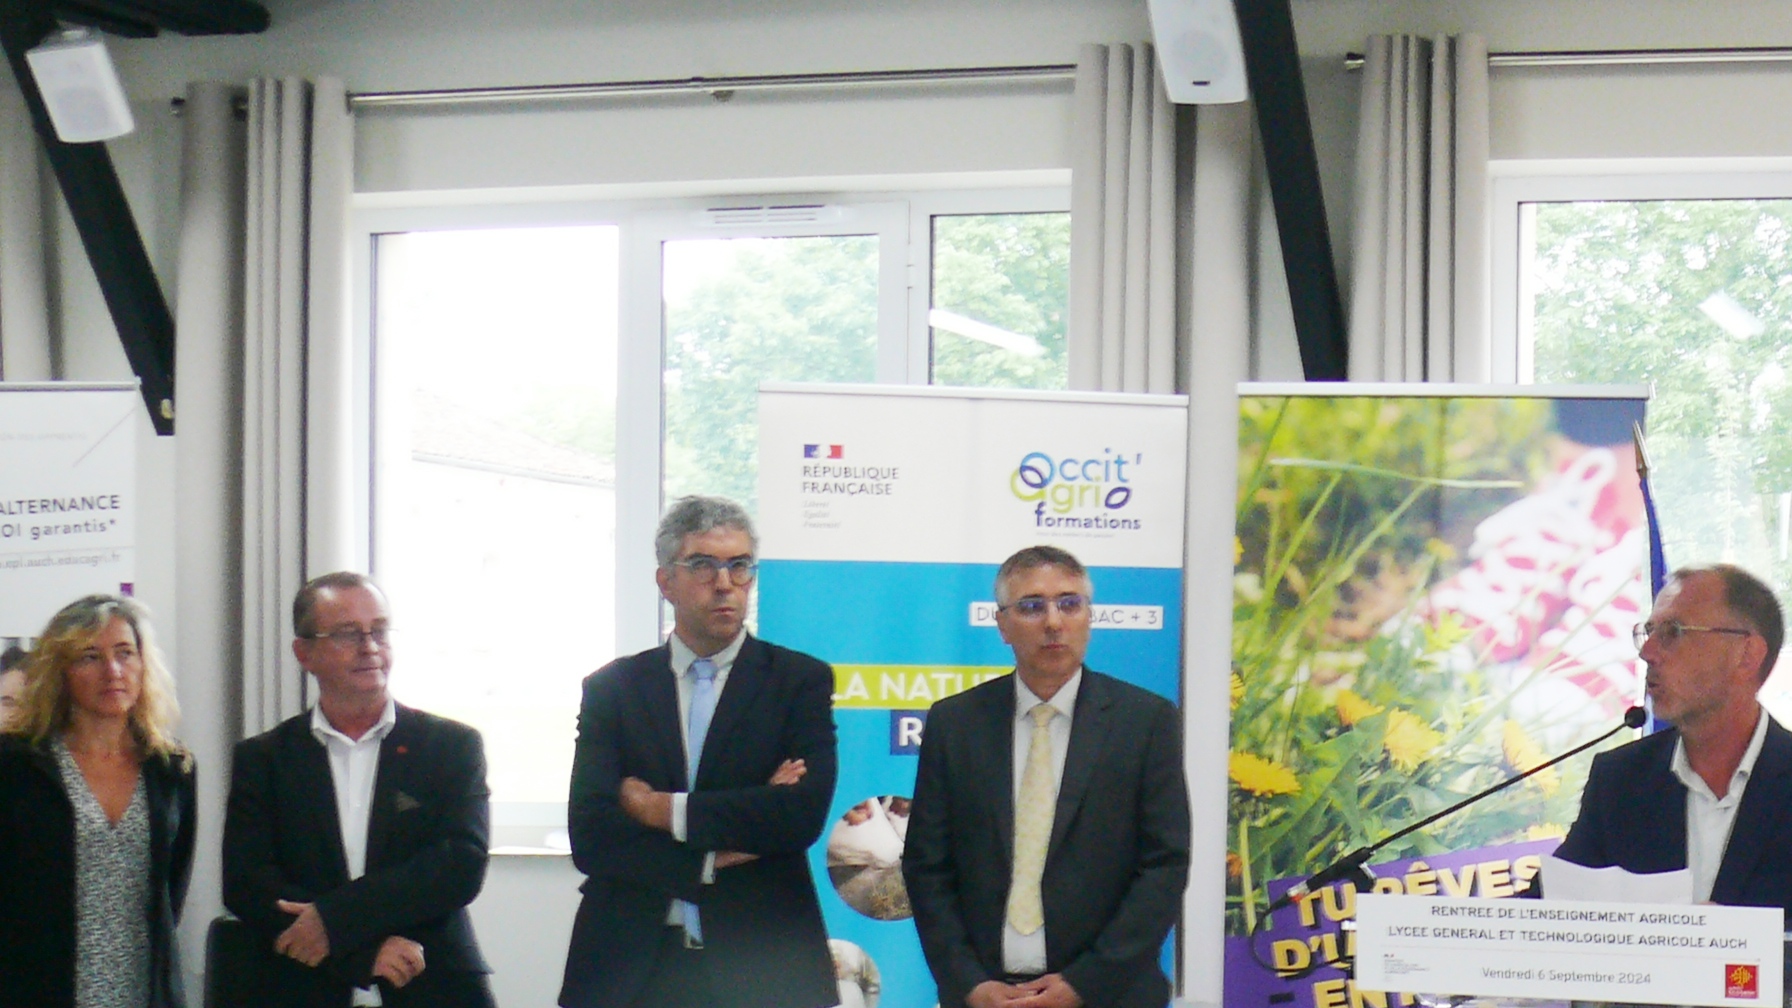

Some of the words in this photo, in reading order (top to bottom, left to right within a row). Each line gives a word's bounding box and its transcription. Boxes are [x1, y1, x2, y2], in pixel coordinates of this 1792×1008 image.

[803, 464, 900, 481] RÉPUBLIQUE
[802, 481, 893, 496] FRANÇAISE
[1034, 500, 1142, 530] formations
[1147, 610, 1158, 625] 3
[1299, 882, 1357, 927] TU
[1431, 905, 1494, 918] RENTREE
[1498, 907, 1516, 919] DE
[1519, 908, 1635, 923] L'ENSEIGNEMENT
[1639, 912, 1707, 926] AGRICOLE
[1388, 926, 1429, 938] LYCEE
[1433, 927, 1496, 940] GENERAL
[1499, 929, 1516, 941] ET
[1520, 930, 1635, 945] TECHNOLOGIQUE
[1638, 934, 1706, 948] AGRICOLE
[1709, 937, 1748, 949] AUCH
[1482, 966, 1535, 980] Vendredi
[1538, 969, 1546, 980] 6
[1549, 969, 1615, 982] Septembre
[1618, 972, 1651, 984] 2024
